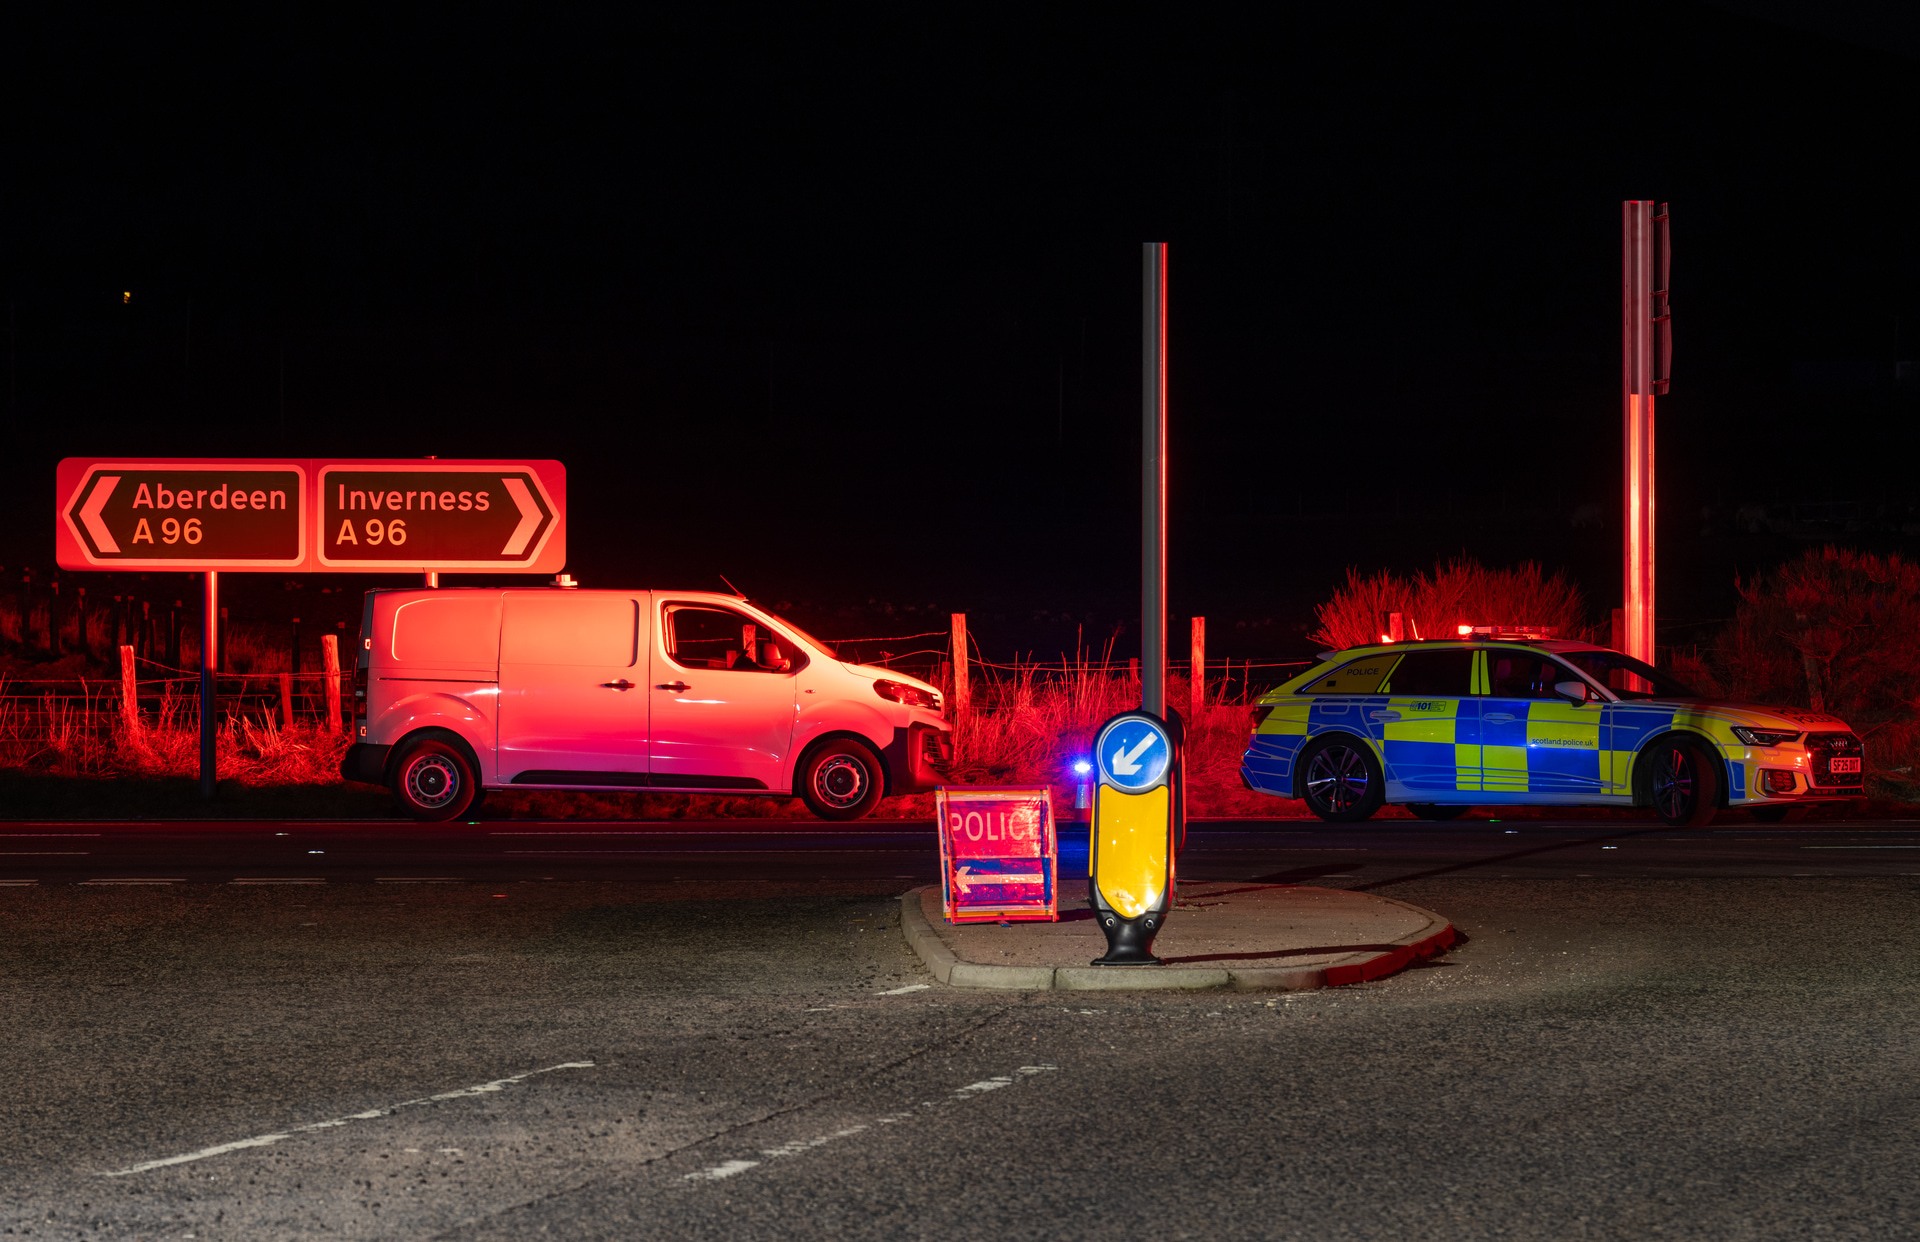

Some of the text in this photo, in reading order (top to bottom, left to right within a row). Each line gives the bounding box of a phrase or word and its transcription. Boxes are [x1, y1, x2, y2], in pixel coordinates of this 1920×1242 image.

[132, 483, 286, 510] Aberdeen
[338, 484, 490, 511] Inverness
[132, 517, 204, 545] A 96
[336, 518, 407, 546] A 96
[1347, 667, 1379, 676] POLICE
[1417, 702, 1432, 711] 101
[950, 811, 1041, 841] POLICE
